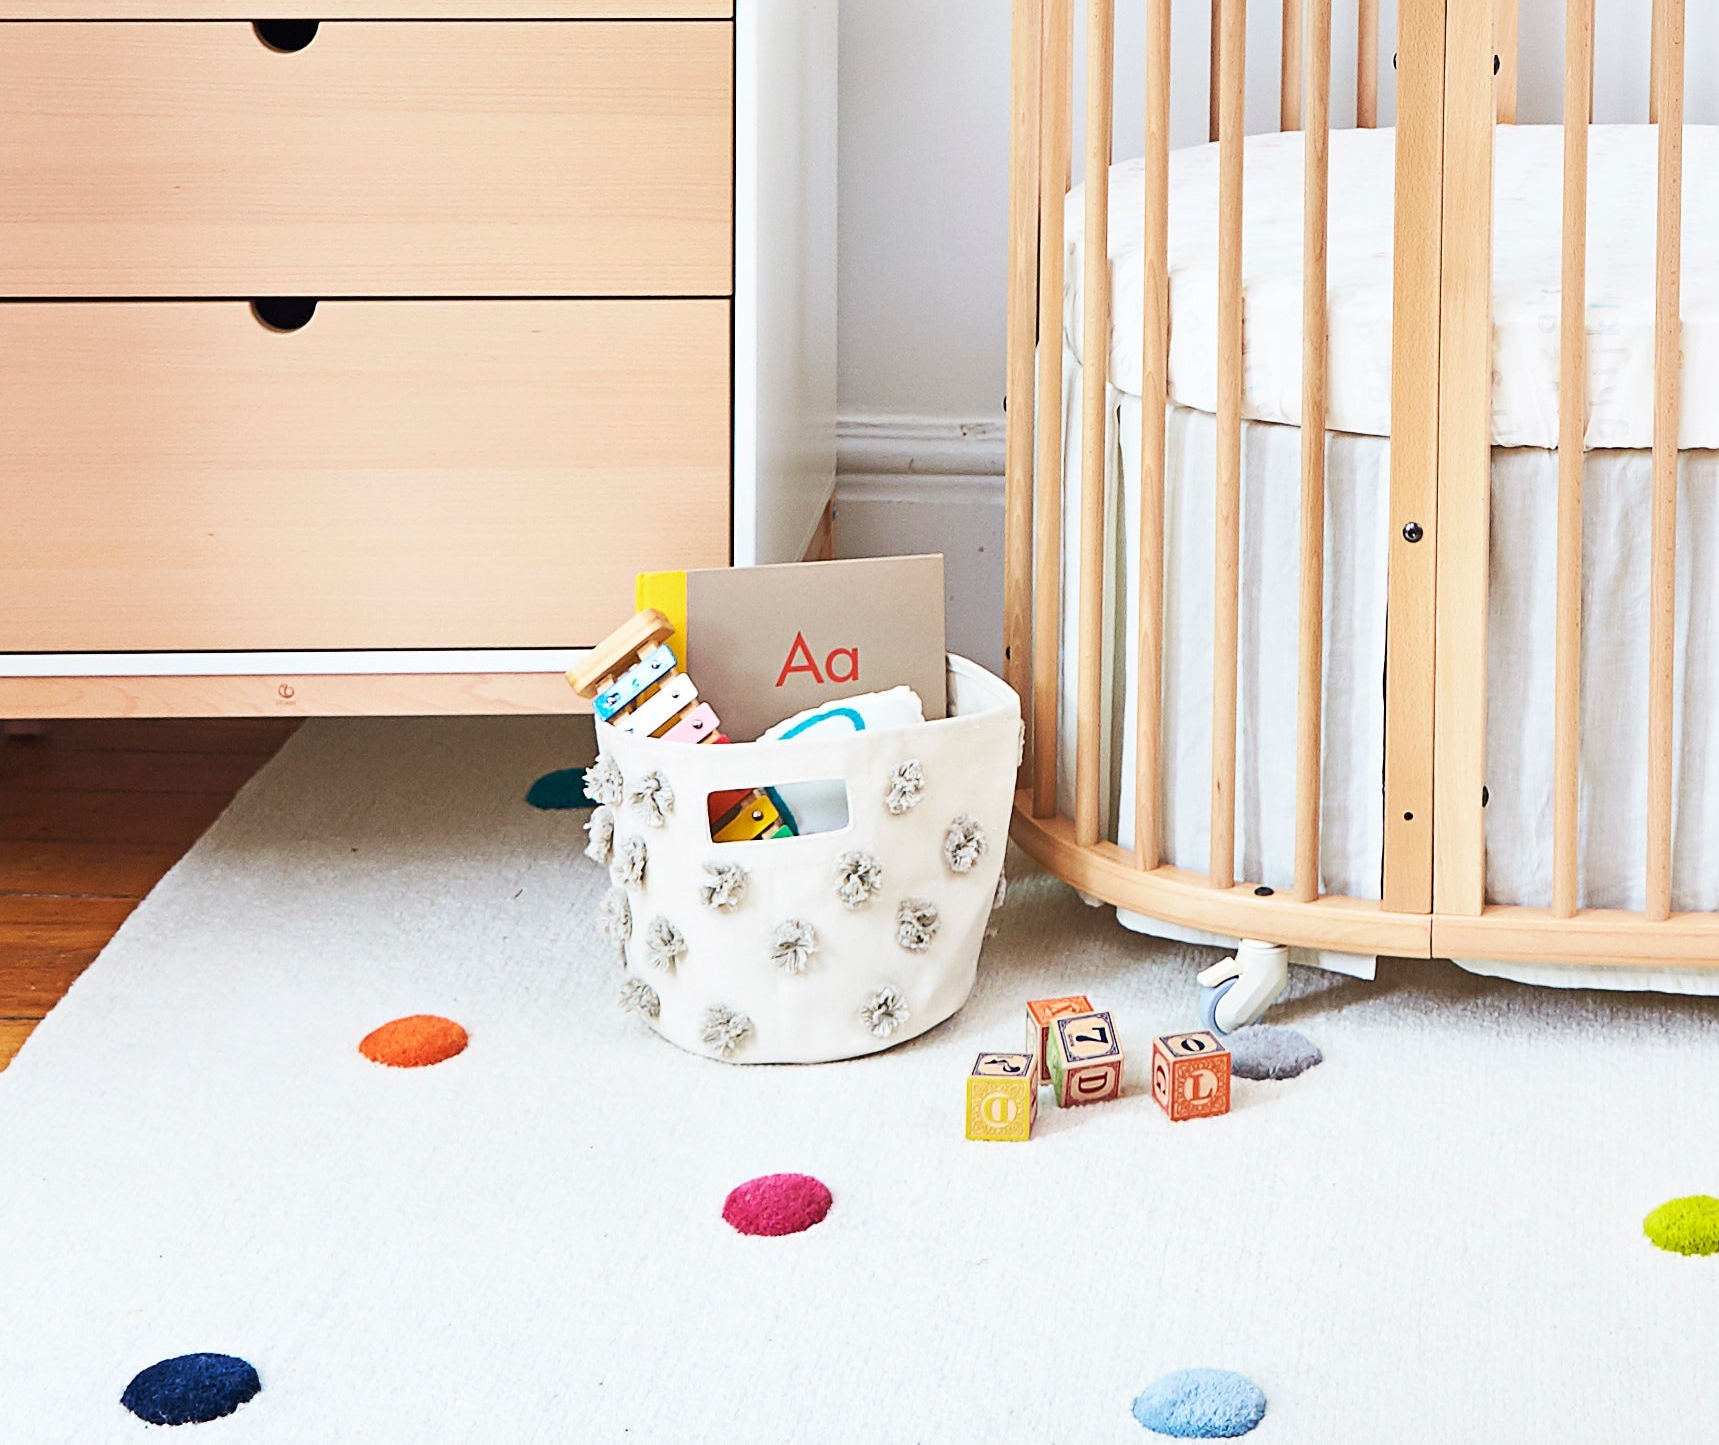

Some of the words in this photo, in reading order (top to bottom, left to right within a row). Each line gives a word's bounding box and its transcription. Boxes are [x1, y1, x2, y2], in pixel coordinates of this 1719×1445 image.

[776, 632, 858, 688] Aa
[1076, 1026, 1108, 1044] 7
[1078, 1071, 1108, 1094] D
[1189, 1074, 1213, 1100] L
